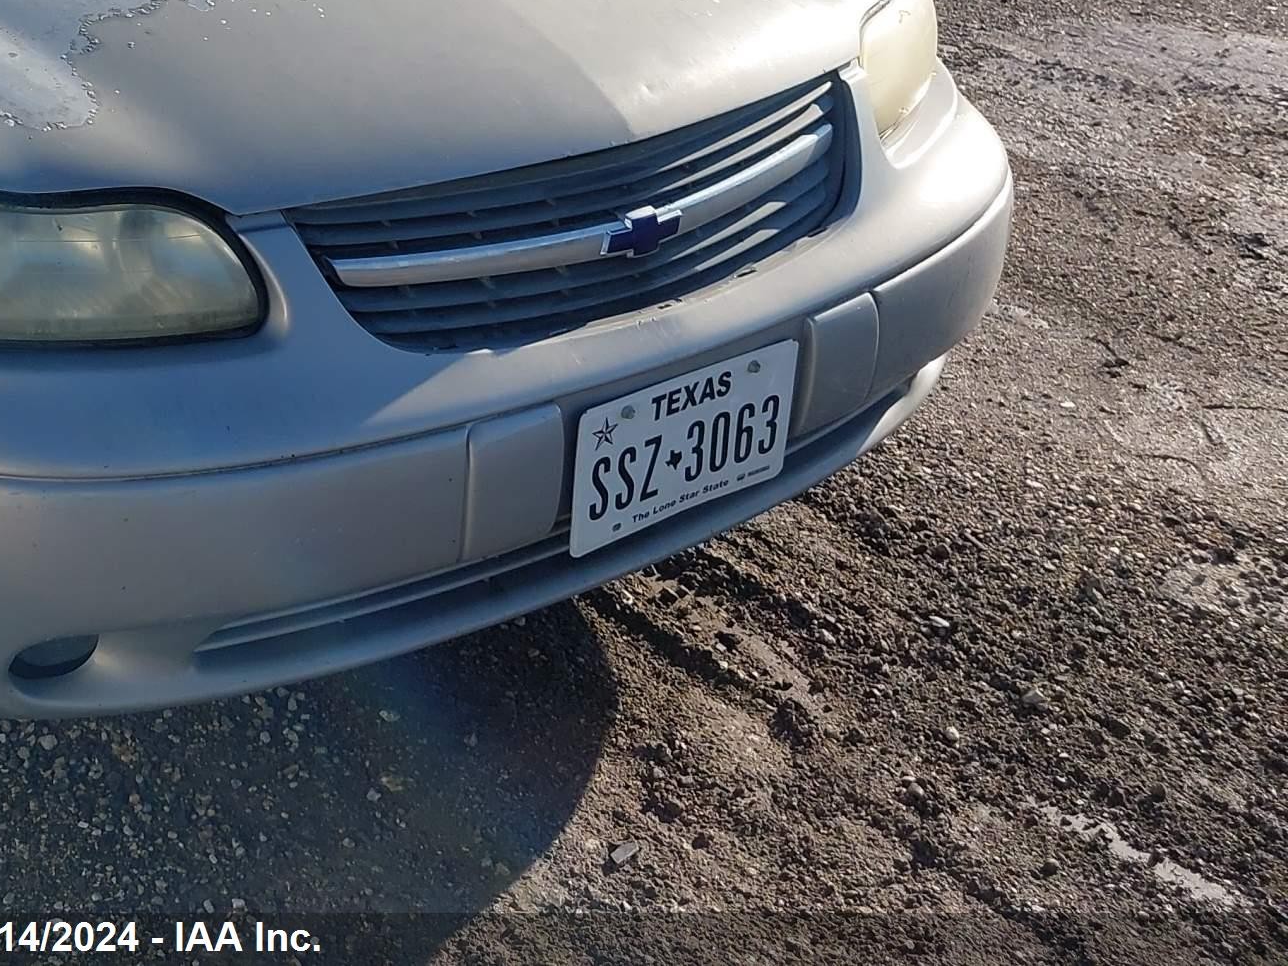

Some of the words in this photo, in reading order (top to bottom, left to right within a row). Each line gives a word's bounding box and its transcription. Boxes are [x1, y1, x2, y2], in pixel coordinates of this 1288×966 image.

[651, 371, 732, 421] TEXAS
[632, 511, 650, 524] The
[652, 499, 676, 516] Lone
[678, 490, 700, 504] Star
[702, 479, 729, 494] State
